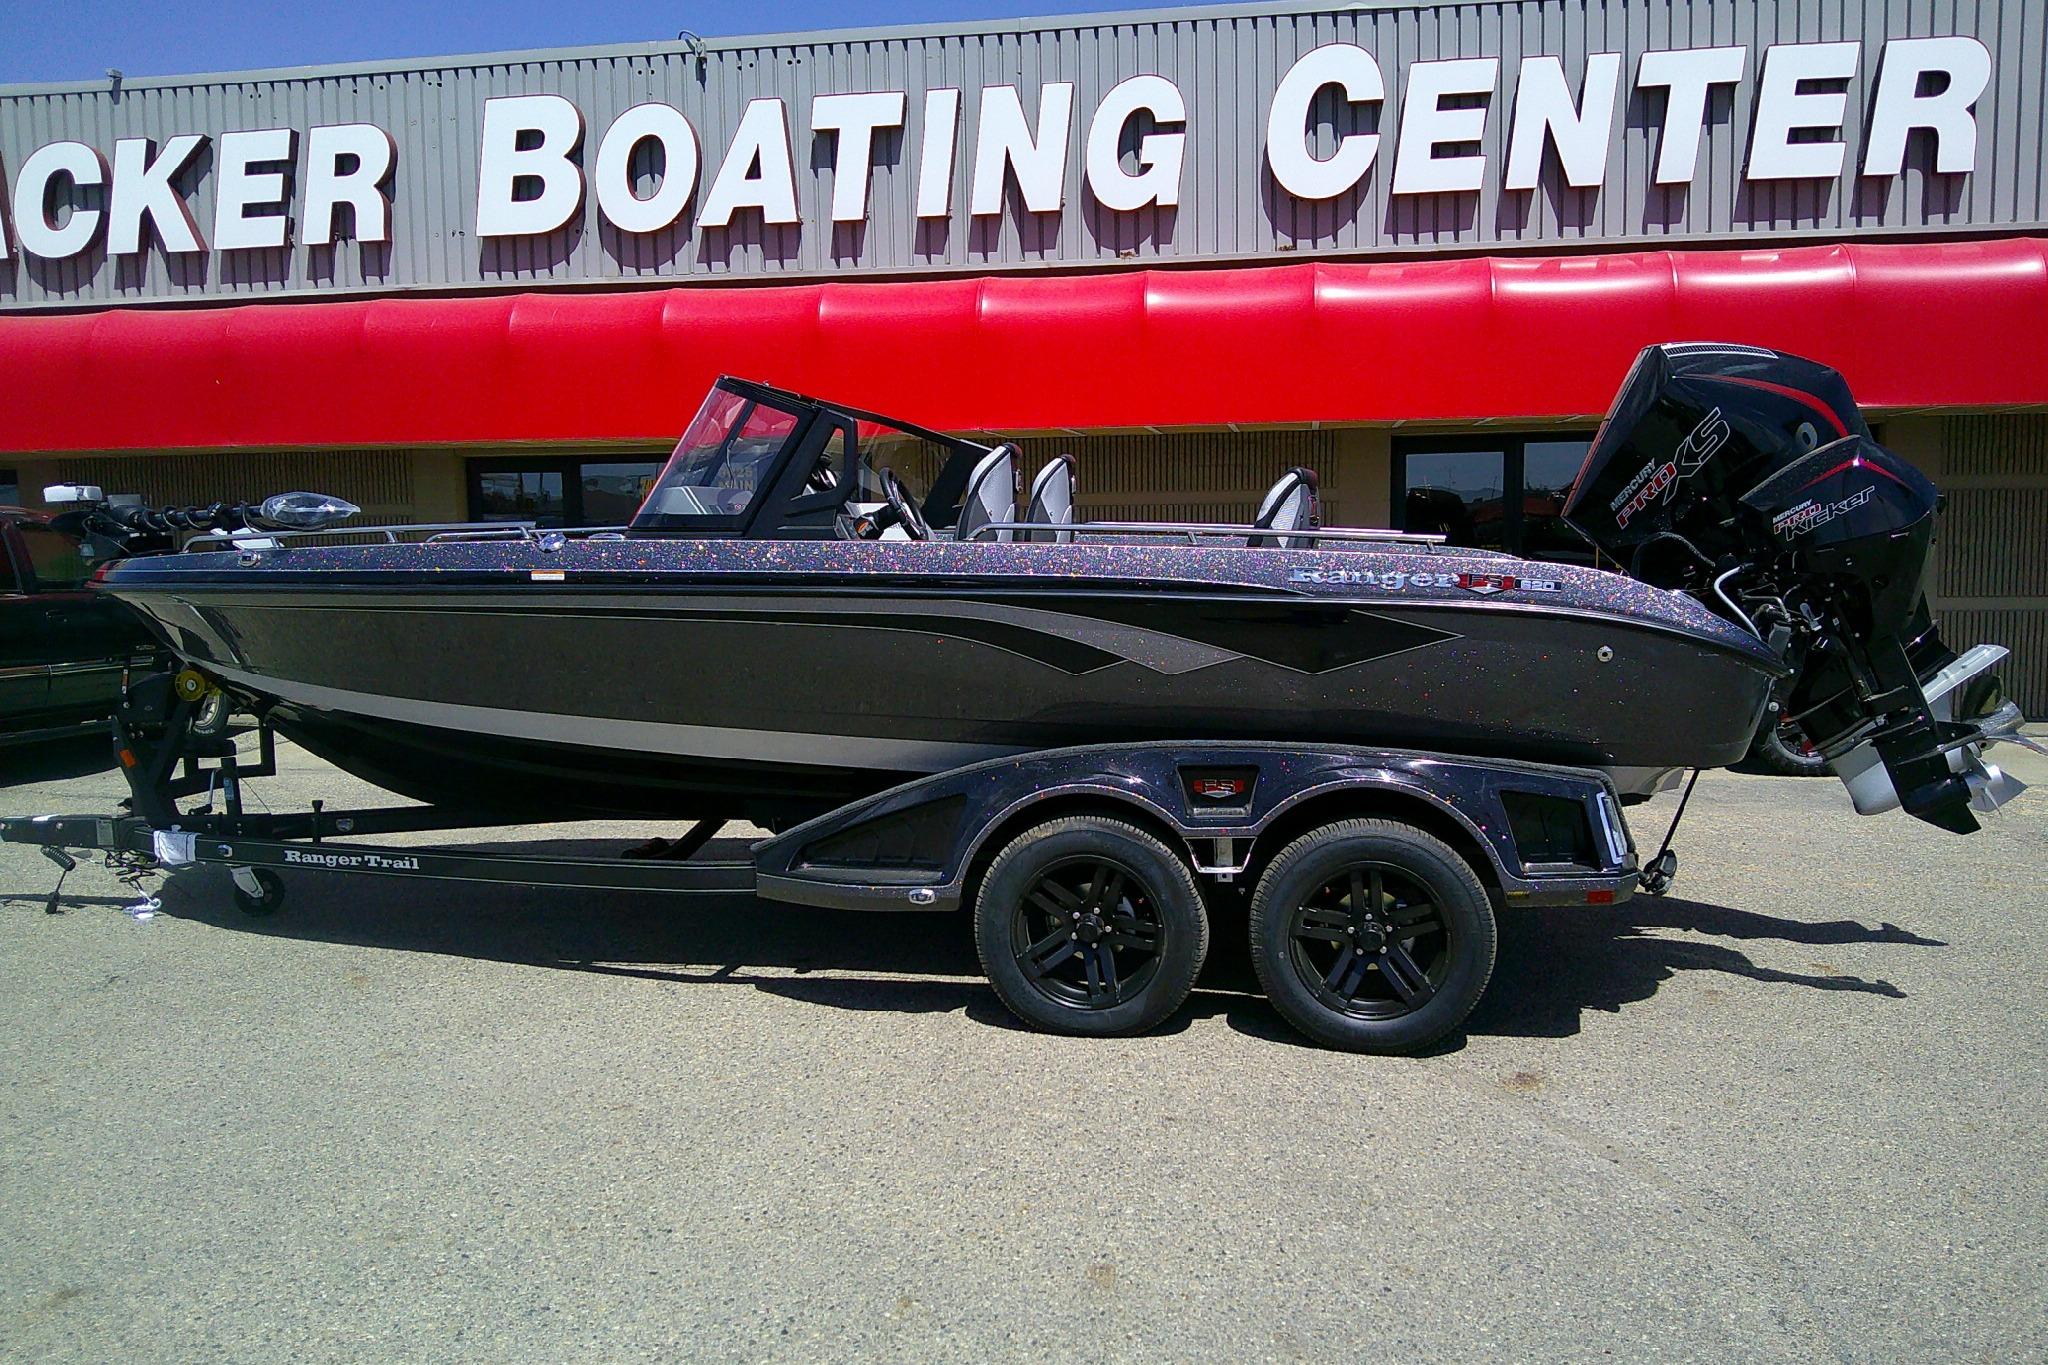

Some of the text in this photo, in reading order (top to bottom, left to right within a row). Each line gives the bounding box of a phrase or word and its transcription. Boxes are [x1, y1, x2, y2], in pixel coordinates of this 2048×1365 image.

[0, 35, 1993, 259] CKER BOATING CENTER
[1609, 457, 1656, 512] MERCURY
[1616, 461, 1678, 530] PRO
[1772, 499, 1813, 525] MERCURY
[1773, 503, 1822, 536] PRO
[1288, 567, 1459, 590] Ranger
[284, 850, 420, 870] Ranger Trail
